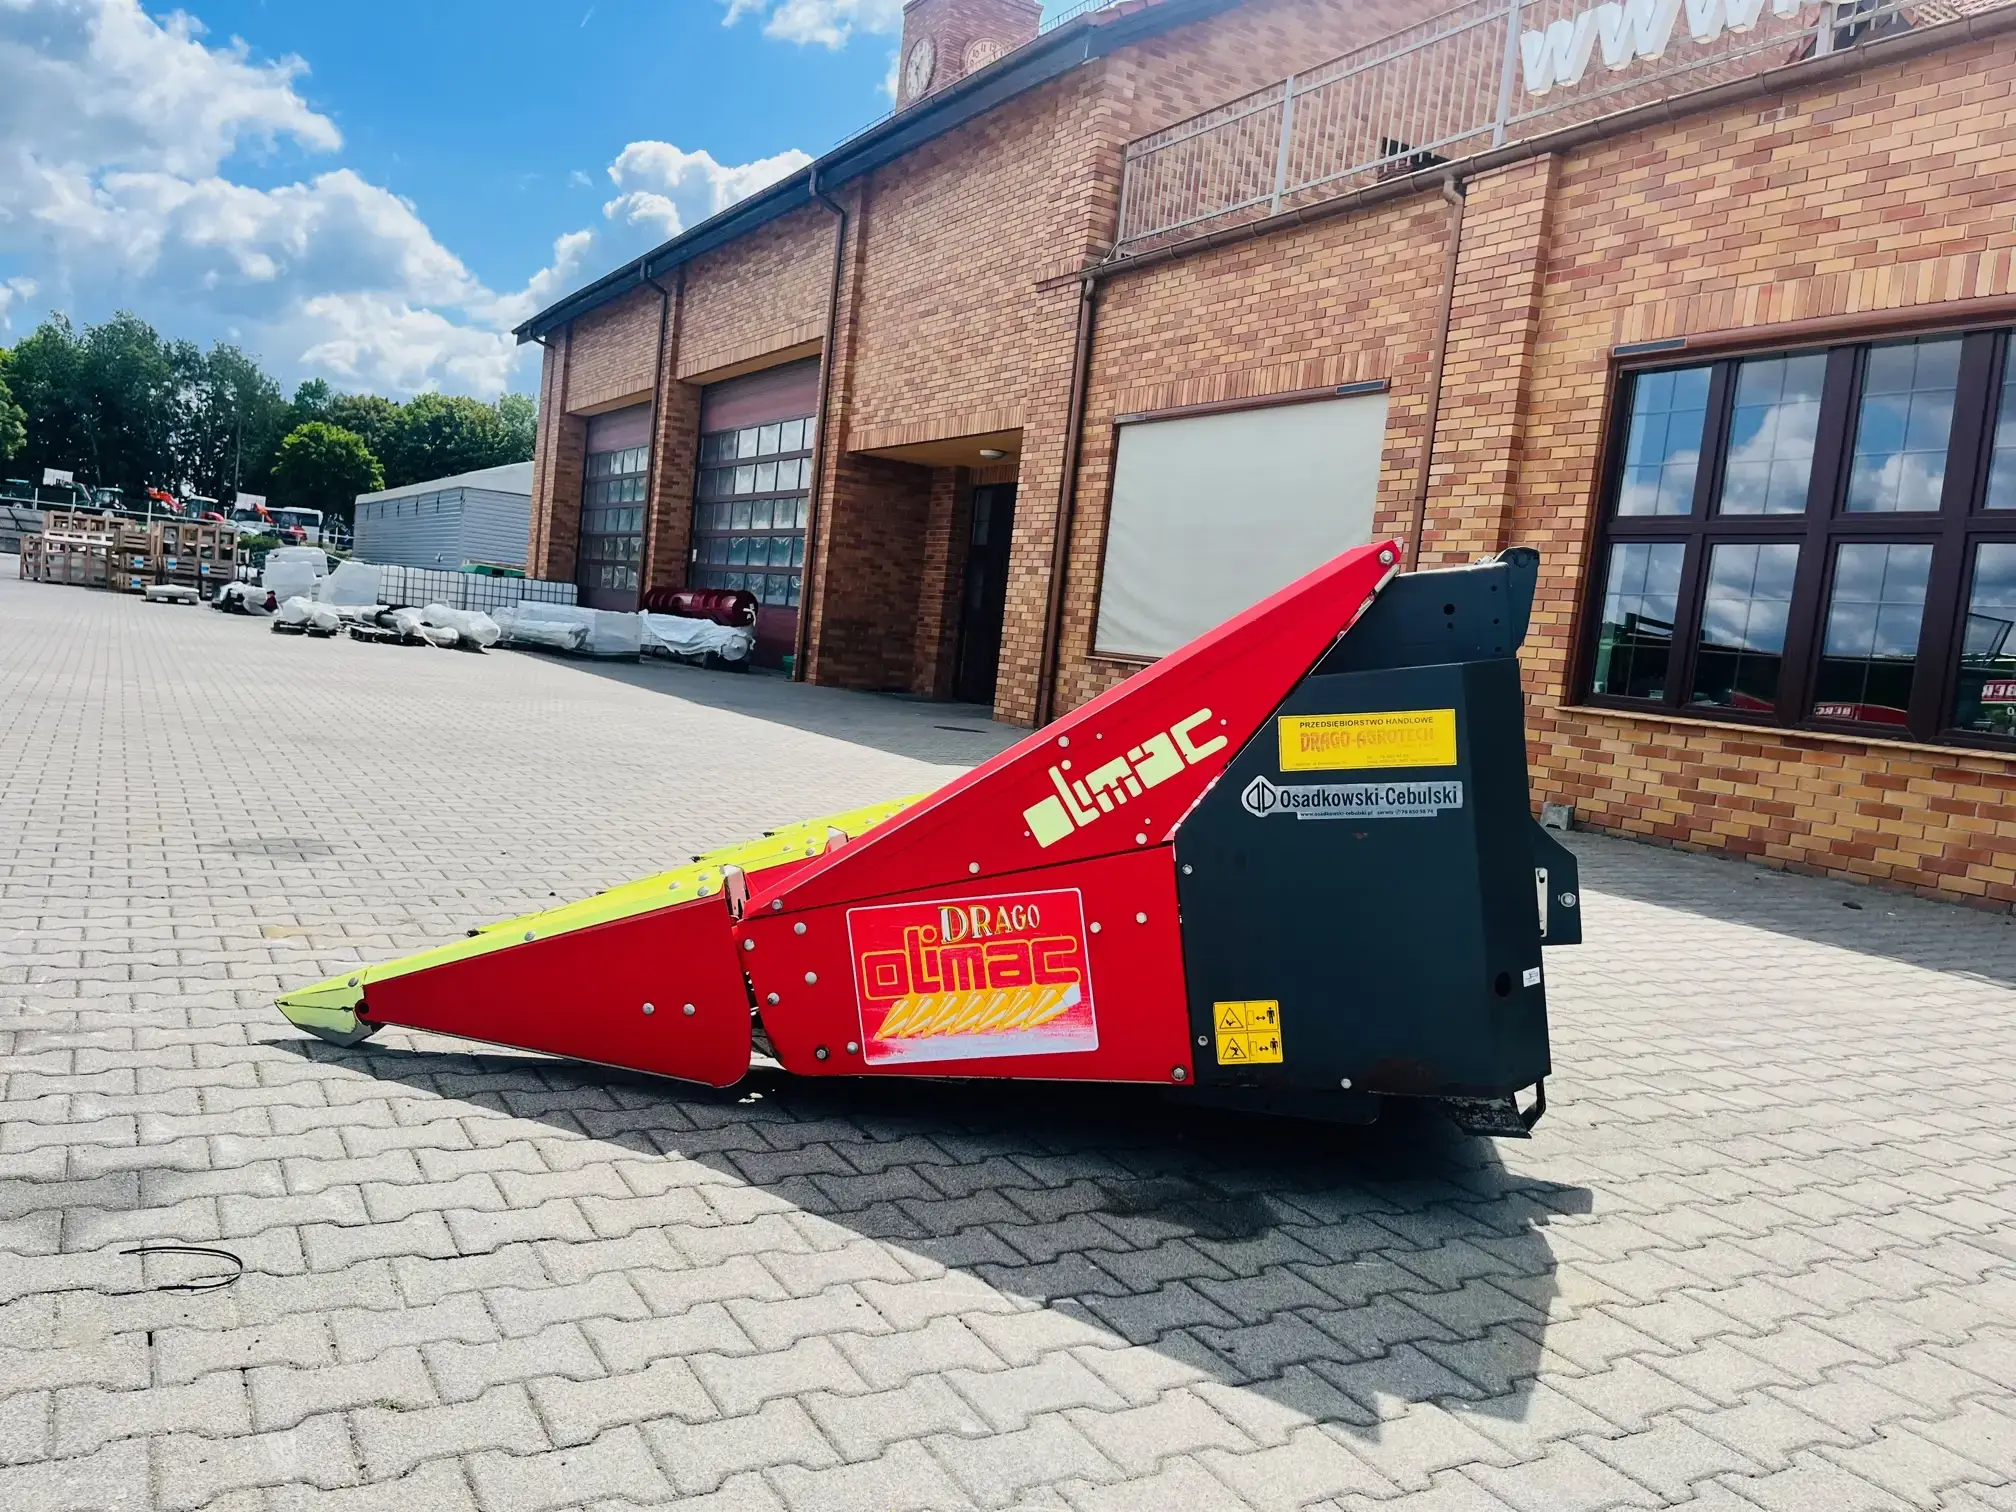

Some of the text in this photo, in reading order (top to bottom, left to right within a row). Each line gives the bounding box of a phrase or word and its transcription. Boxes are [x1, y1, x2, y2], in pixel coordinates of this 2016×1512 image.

[1299, 716, 1434, 729] PRZEDSIĘBIORSTWO HANDLOWE
[1280, 786, 1458, 808] Osadkowski-Cebulski
[938, 904, 1041, 944] DRAGO
[861, 925, 1082, 1001] olimac
